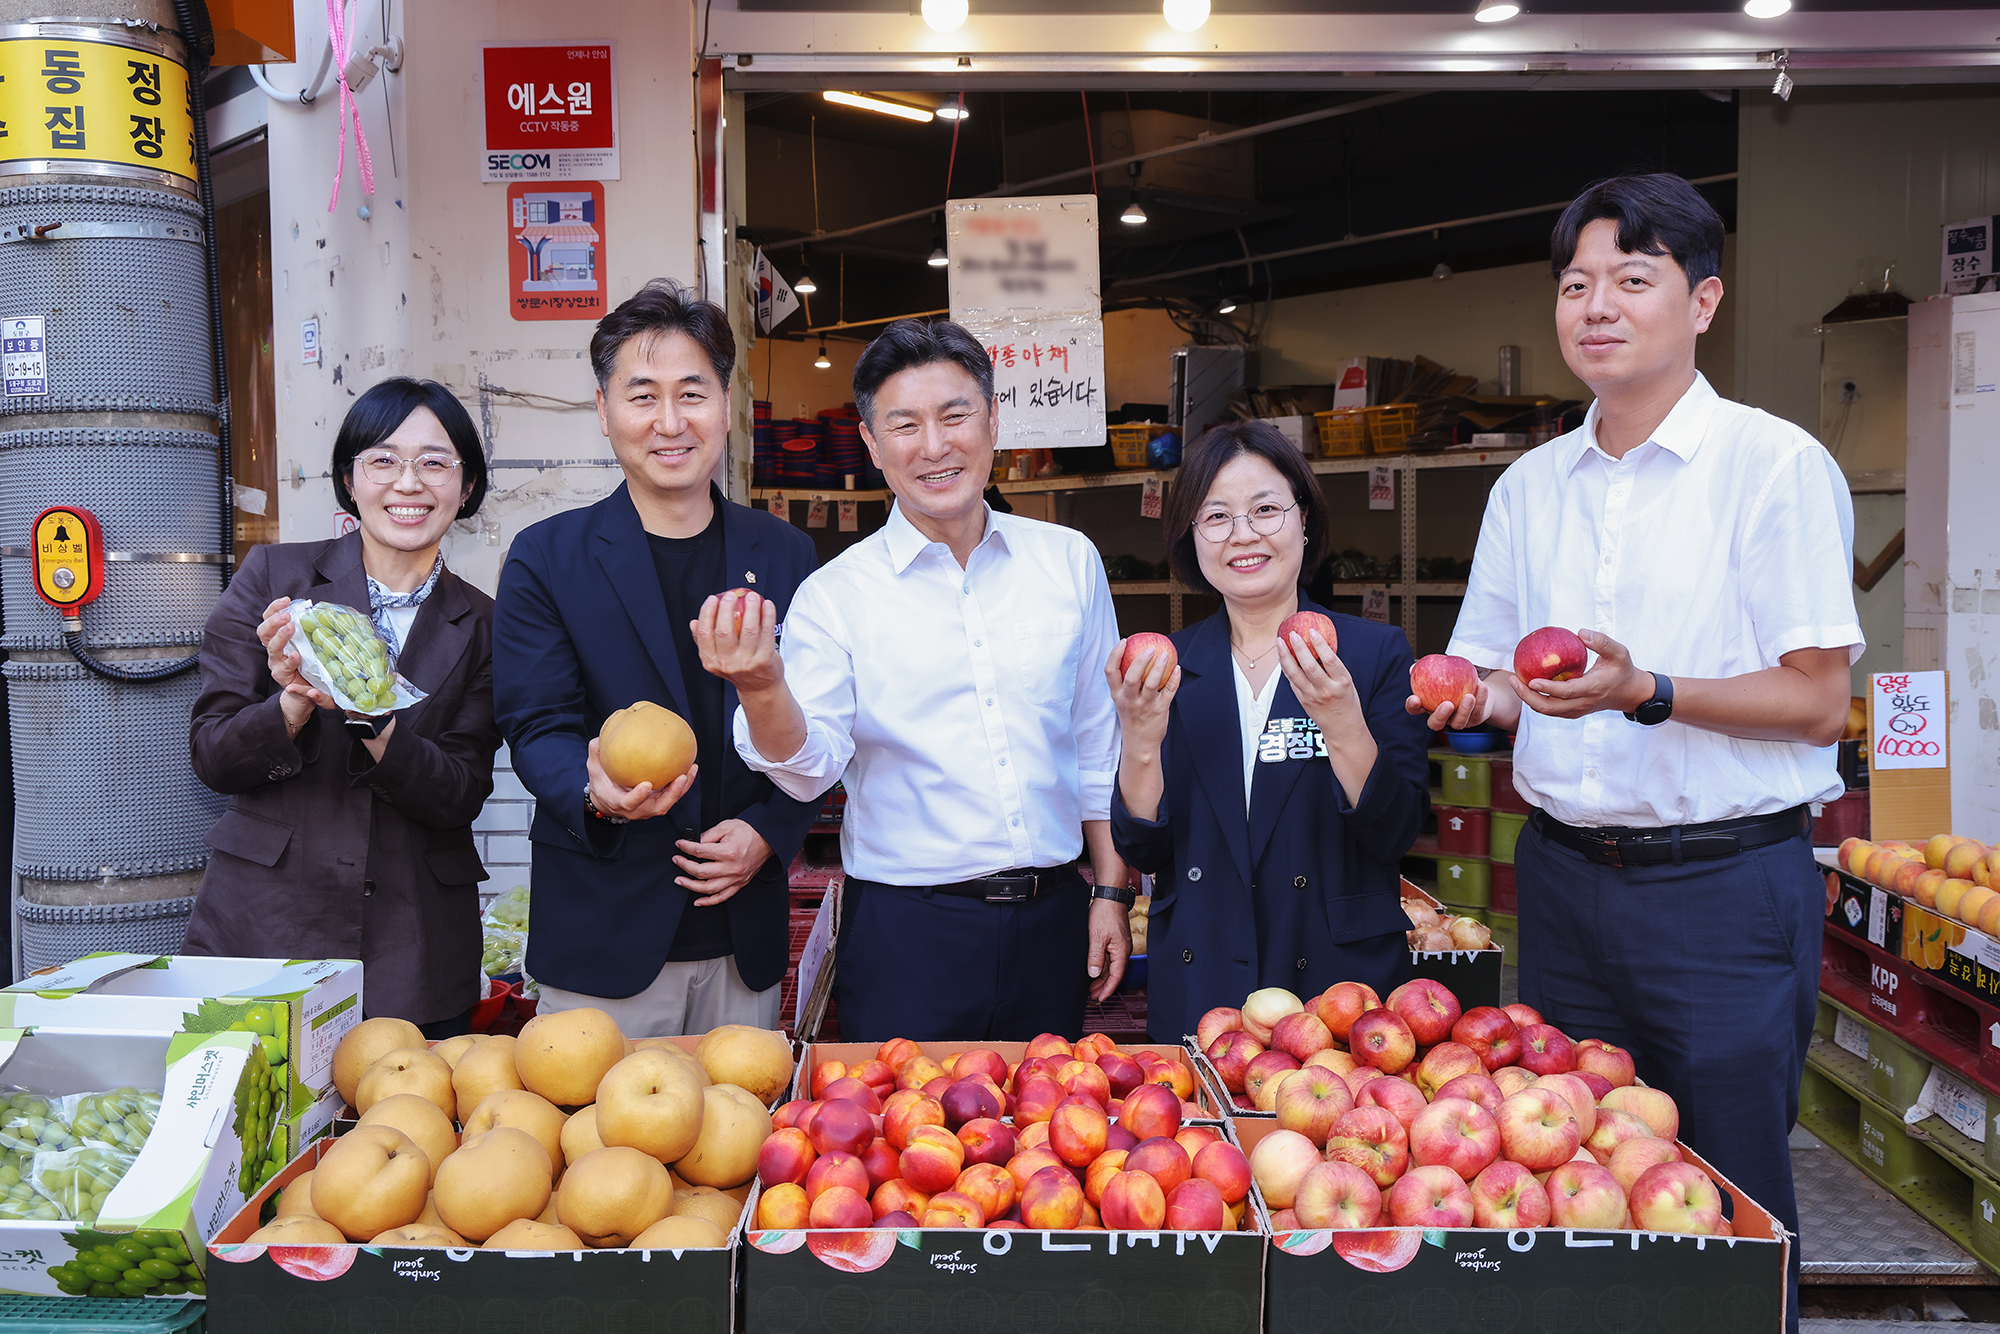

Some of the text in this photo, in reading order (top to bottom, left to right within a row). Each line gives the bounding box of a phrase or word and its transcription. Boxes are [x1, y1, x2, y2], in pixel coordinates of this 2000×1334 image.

[567, 50, 608, 60] 언제나 안심
[507, 82, 592, 116] 에스원
[519, 120, 580, 132] CCTV 작동중
[488, 153, 551, 170] SECOM
[1951, 255, 1982, 272] 장수
[516, 296, 600, 309] 쌍문시장상인회
[7, 339, 40, 352] 보안등
[7, 361, 42, 377] 03-19-15
[996, 376, 1097, 408] 에 있습니다
[47, 516, 74, 525] 도봉구
[42, 543, 83, 554] 비상벨
[1890, 694, 1931, 713] 황도
[1877, 734, 1941, 757] 10000
[1871, 963, 1899, 995] KPP
[186, 1050, 220, 1109] 샤인머스켓
[206, 1160, 237, 1241] 샤인머스켓
[930, 1250, 962, 1265] goeul
[1454, 1248, 1487, 1263] goeul
[392, 1256, 426, 1272] goeul
[935, 1262, 978, 1274] Sunbee
[1459, 1260, 1501, 1273] Sunbee
[398, 1269, 441, 1282] Sunbee
